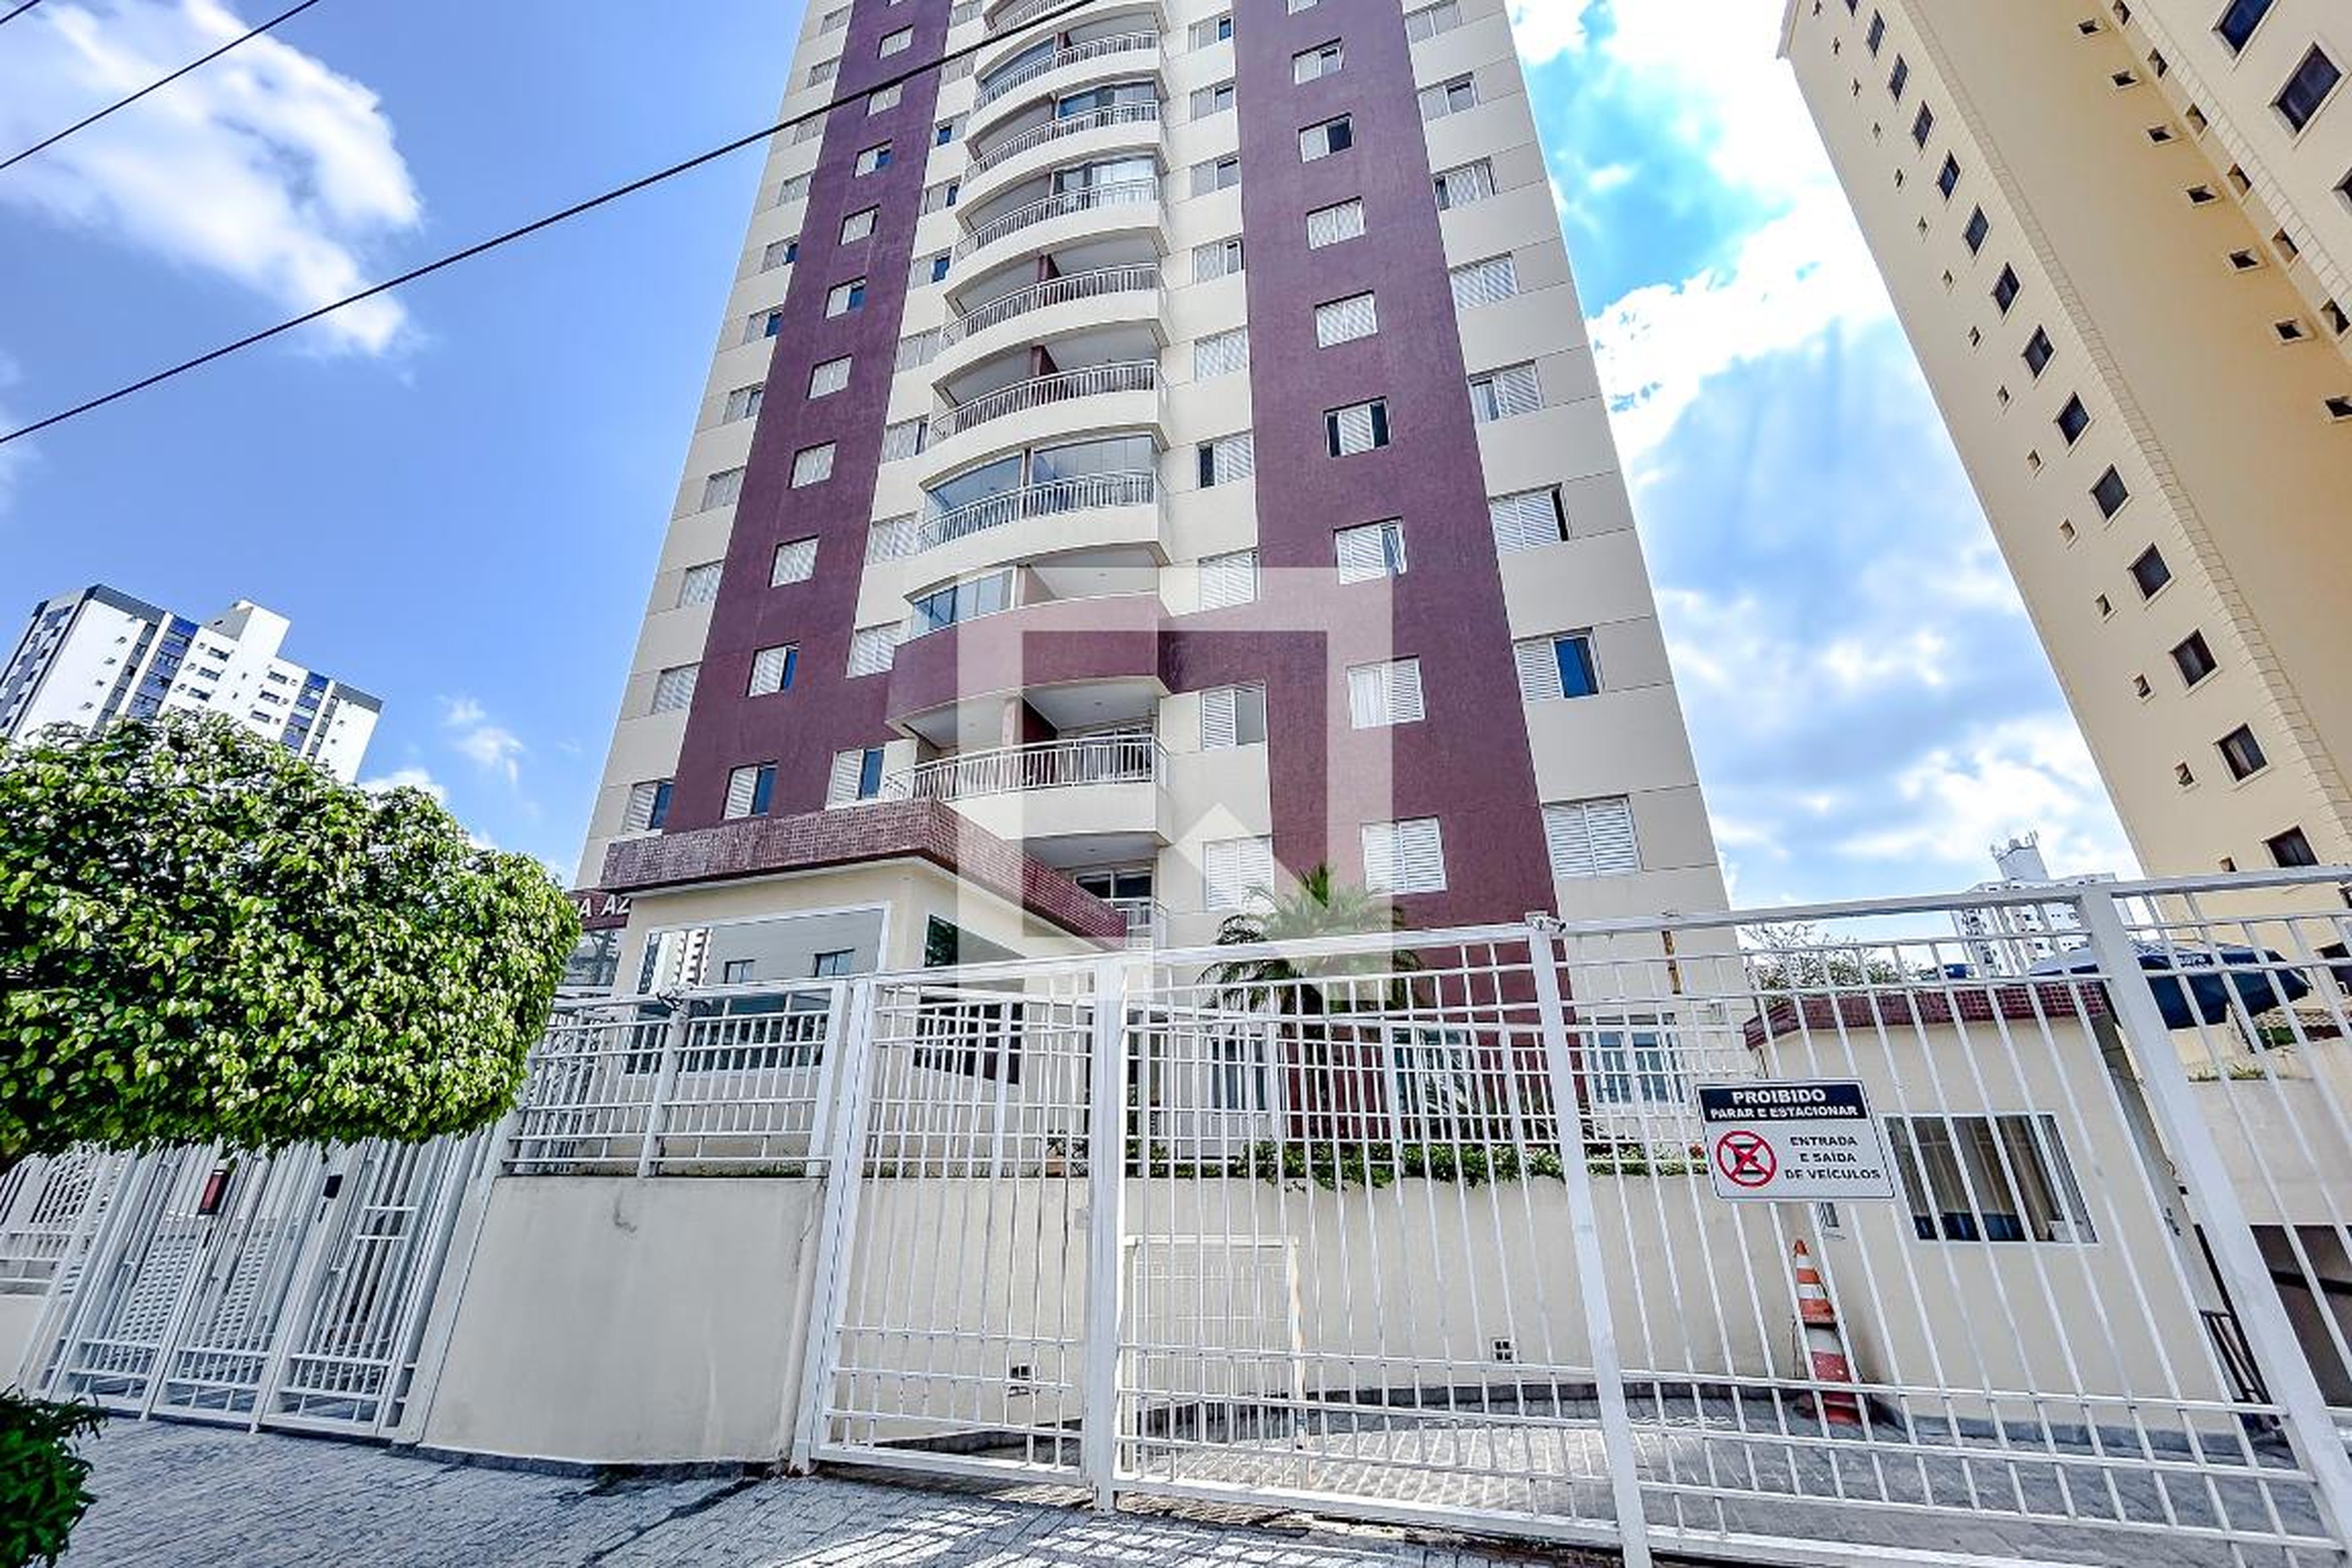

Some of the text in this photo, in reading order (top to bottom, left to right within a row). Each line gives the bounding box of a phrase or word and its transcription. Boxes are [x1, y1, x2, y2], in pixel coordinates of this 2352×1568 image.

[1732, 1088, 1826, 1104] PROIBIDO
[1710, 1106, 1858, 1119] PARAR E ESTACIONAR
[1790, 1136, 1858, 1146] ENTRADA
[1800, 1153, 1809, 1162] E
[1785, 1169, 1803, 1179] DE
